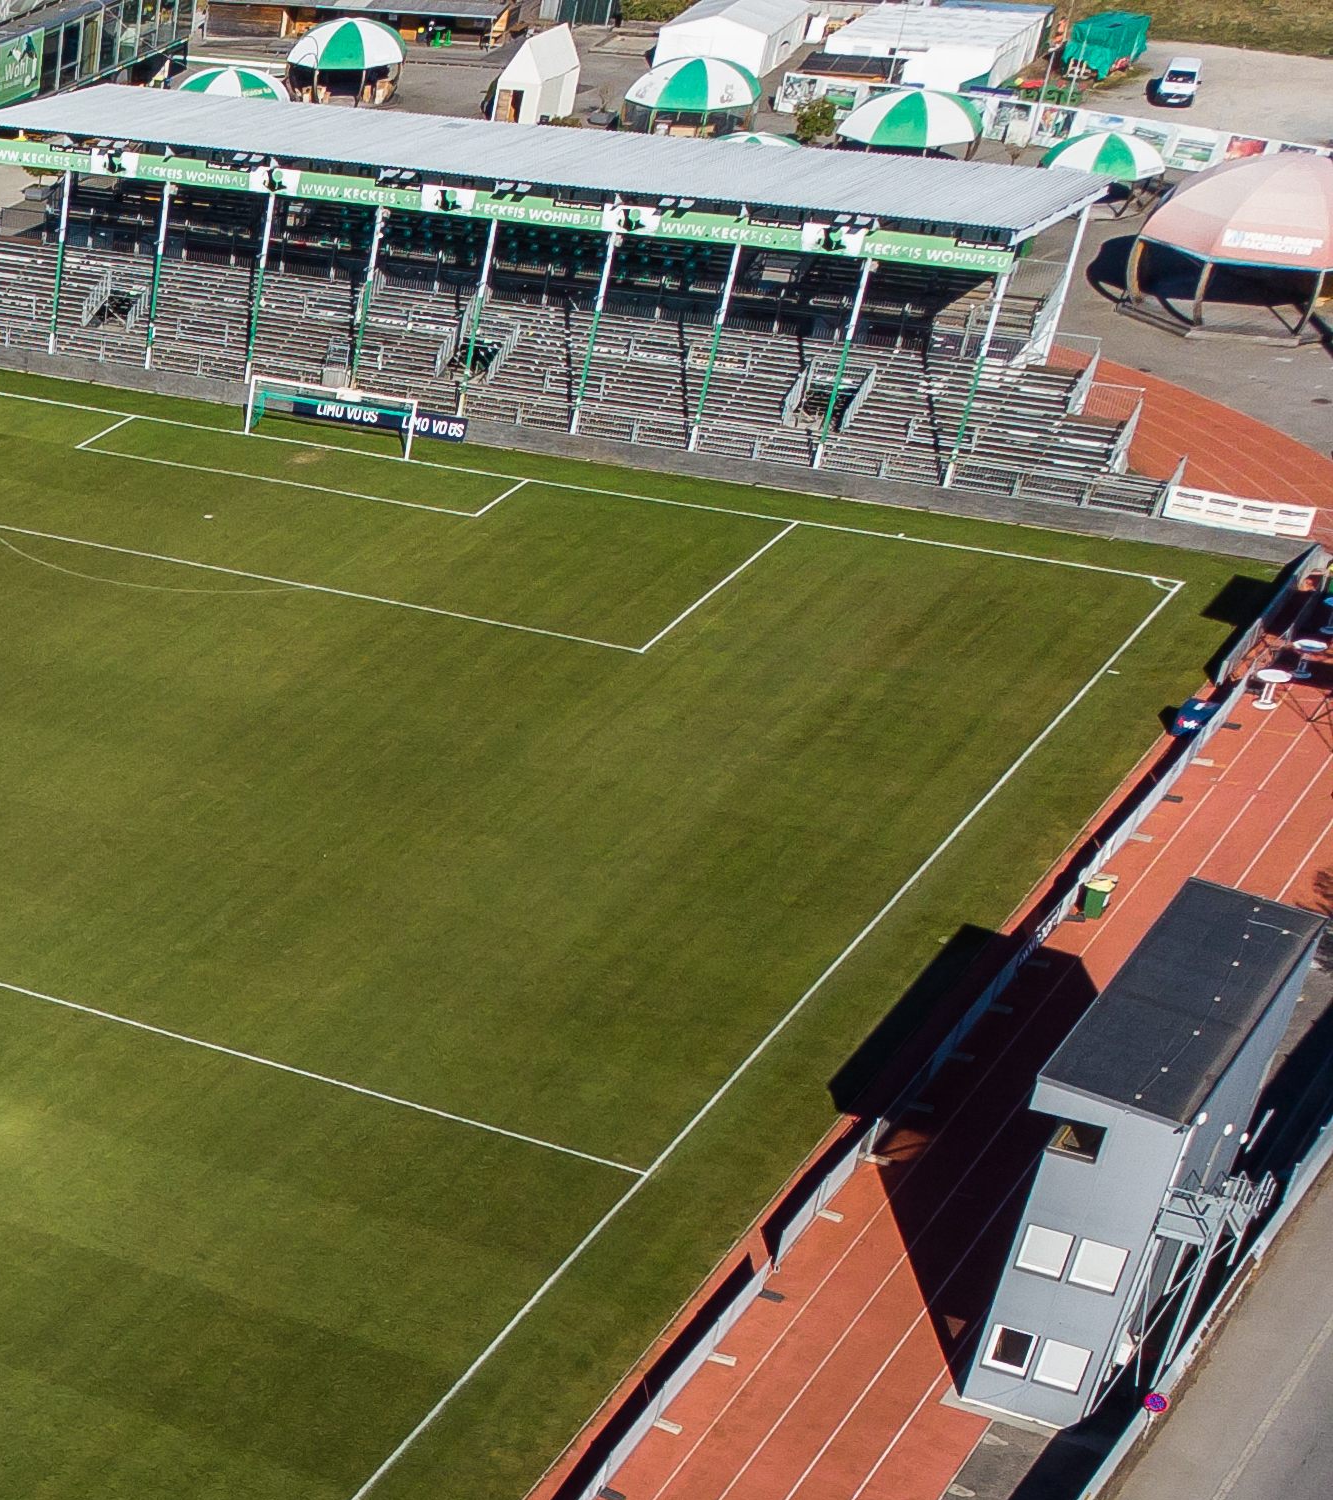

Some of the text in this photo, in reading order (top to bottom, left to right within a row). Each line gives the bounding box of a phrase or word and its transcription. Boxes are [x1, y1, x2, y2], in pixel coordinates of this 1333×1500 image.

[316, 403, 344, 418] LIMO
[346, 407, 360, 420] VO
[401, 416, 430, 432] LMO
[432, 419, 446, 435] VO
